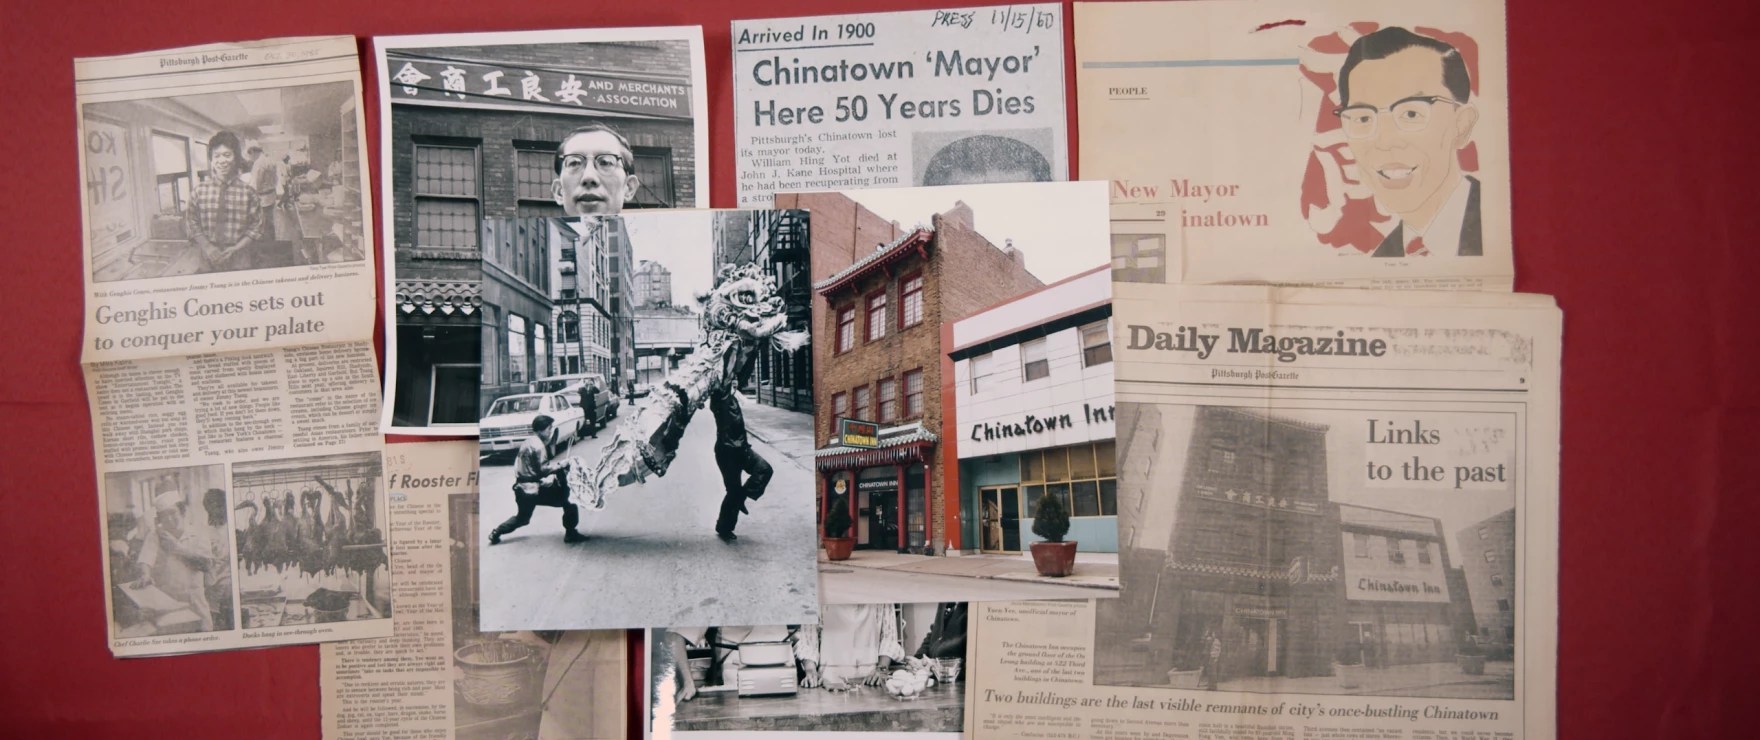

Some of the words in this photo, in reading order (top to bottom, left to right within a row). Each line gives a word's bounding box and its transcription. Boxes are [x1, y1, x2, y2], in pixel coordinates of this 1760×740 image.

[932, 10, 975, 28] PRESS
[738, 22, 804, 44] Arrived
[811, 22, 829, 41] In
[837, 22, 876, 40] 1900
[160, 56, 200, 68] Pittsburgh
[202, 53, 248, 65] Post-Gazette
[753, 56, 914, 86] Chinatown
[589, 80, 613, 92] AND
[618, 82, 685, 96] MERCHANTS
[1109, 87, 1148, 95] PEOPLE
[754, 99, 825, 126] Here
[835, 95, 868, 123] 50
[878, 93, 961, 119] Years
[973, 88, 1035, 115] Dies
[751, 133, 813, 146] Pittsburgh's
[818, 131, 872, 142] Chinatown
[879, 129, 897, 139] lost
[741, 149, 753, 157] its
[758, 147, 790, 157] mayor
[795, 145, 825, 156] today.
[751, 158, 791, 168] William
[800, 156, 825, 166] Hing
[832, 154, 850, 164] Yot
[859, 153, 879, 162] died
[887, 152, 897, 161] at
[741, 170, 766, 180] John
[772, 170, 780, 179] J.
[787, 168, 813, 177] Kane
[819, 165, 861, 177] Hospital
[867, 164, 898, 173] where
[742, 182, 753, 191] he
[757, 180, 776, 191] had
[778, 179, 801, 189] been
[805, 175, 870, 189] recuperating
[873, 174, 898, 184] from
[1113, 179, 1159, 199] New
[1170, 178, 1240, 203] Mayor
[752, 191, 773, 202] stro
[1182, 210, 1269, 227] inatown
[95, 301, 177, 326] Genghis
[184, 297, 243, 317] Cones
[249, 293, 285, 312] sets
[290, 291, 325, 308] out
[94, 336, 113, 351] to
[120, 329, 204, 350] conquer
[210, 325, 259, 346] your
[264, 317, 325, 341] palate
[1127, 324, 1220, 360] Daily
[1227, 327, 1387, 362] Magazine
[1211, 368, 1253, 379] Pittsburgh
[971, 414, 1072, 442] Chinatown
[1367, 419, 1441, 445] Links
[1367, 461, 1393, 481] to
[1402, 456, 1445, 481] the
[1454, 463, 1506, 489] past
[401, 474, 462, 489] Rooster
[1358, 578, 1418, 594] Chinatown
[984, 689, 1012, 704] Two
[1017, 690, 1077, 709] buildings
[1080, 697, 1102, 707] are
[1106, 695, 1128, 709] the
[1132, 695, 1154, 710] last
[1160, 698, 1202, 712] visible
[1205, 702, 1268, 716] remnants
[1271, 702, 1286, 716] of
[1328, 704, 1419, 722] once-bustling
[1424, 705, 1499, 721] Chinatown
